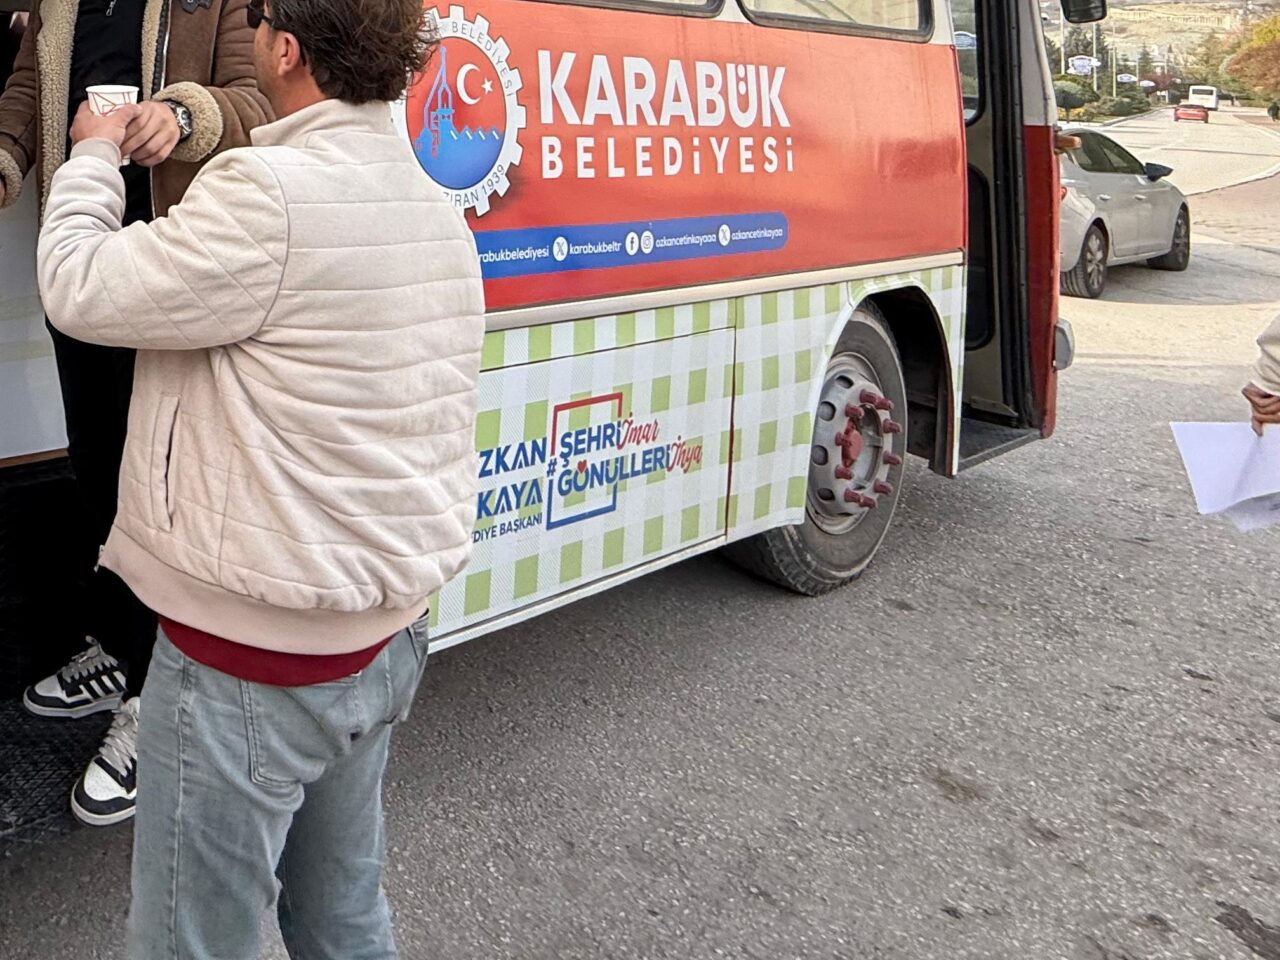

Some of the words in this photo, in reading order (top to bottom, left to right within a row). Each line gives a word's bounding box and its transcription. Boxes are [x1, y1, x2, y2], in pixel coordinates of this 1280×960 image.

[538, 49, 791, 128] KARABÜK
[541, 136, 794, 179] BELEDİYESİ
[481, 164, 505, 195] 1939
[477, 478, 543, 520] KAYA
[500, 512, 543, 536] BAŞKANI
